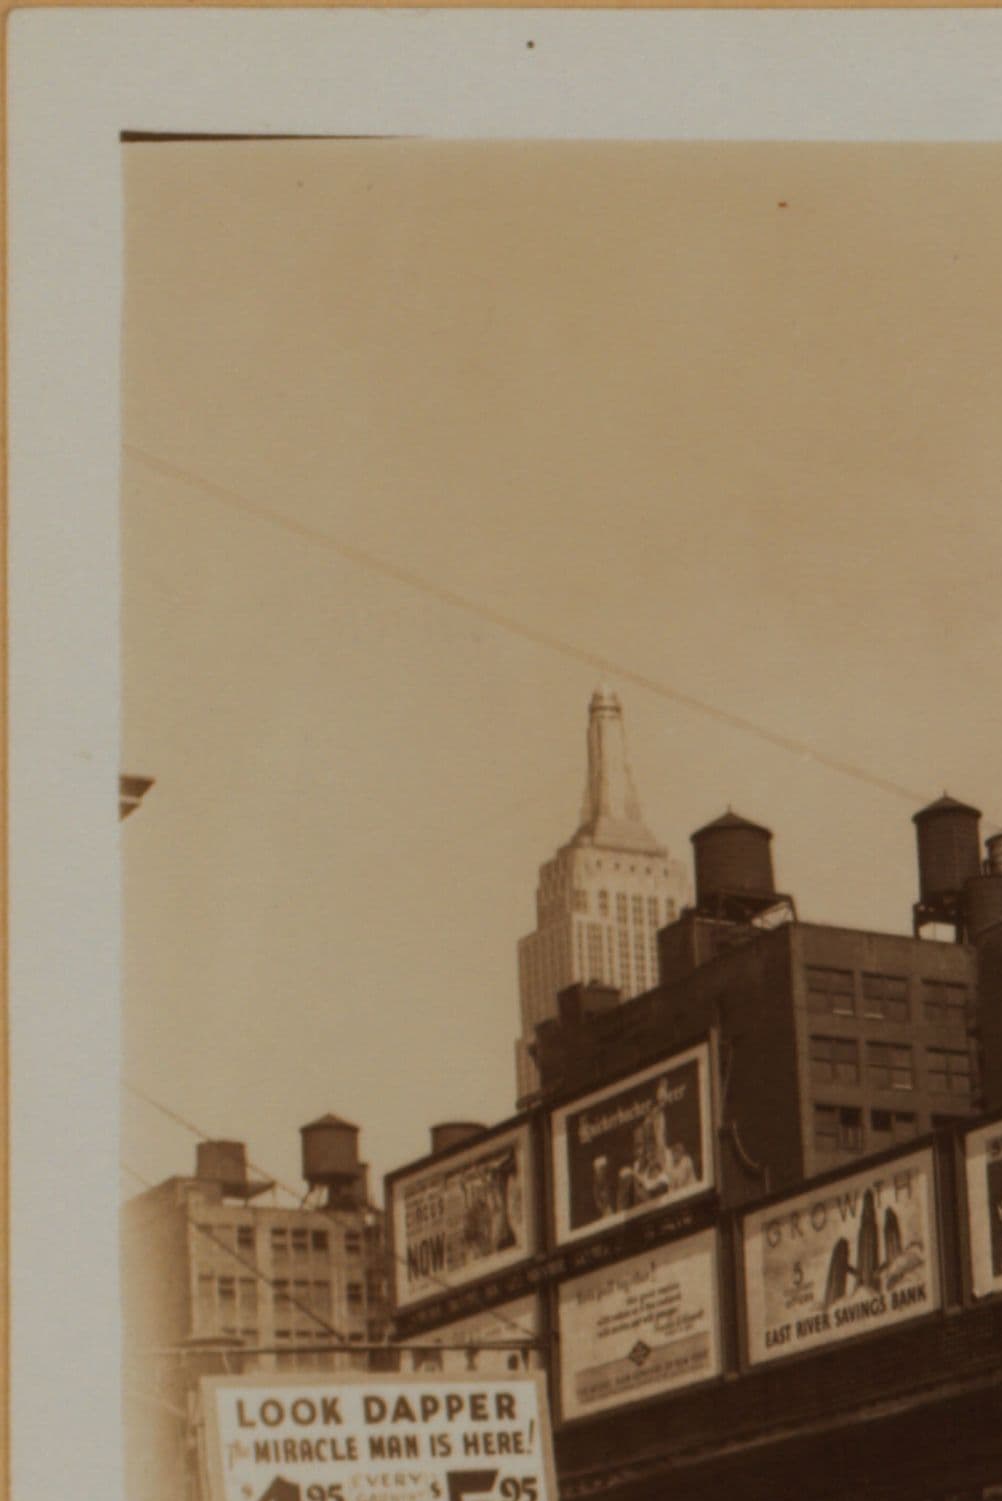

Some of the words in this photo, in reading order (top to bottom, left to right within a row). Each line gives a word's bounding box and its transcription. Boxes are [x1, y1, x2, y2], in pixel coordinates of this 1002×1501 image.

[765, 1172, 912, 1247] GROWTH
[764, 1324, 792, 1351] EAST
[795, 1312, 831, 1340] RIVER
[833, 1294, 887, 1327] SAVINGS
[891, 1284, 927, 1310] BANK
[236, 1396, 344, 1429] LOOK
[362, 1392, 517, 1425] DAPPER
[253, 1436, 359, 1464] MIRACLE
[368, 1433, 419, 1461] MAN
[429, 1432, 453, 1459] IS
[461, 1418, 535, 1458] HERE!
[352, 1472, 423, 1489] EVERY
